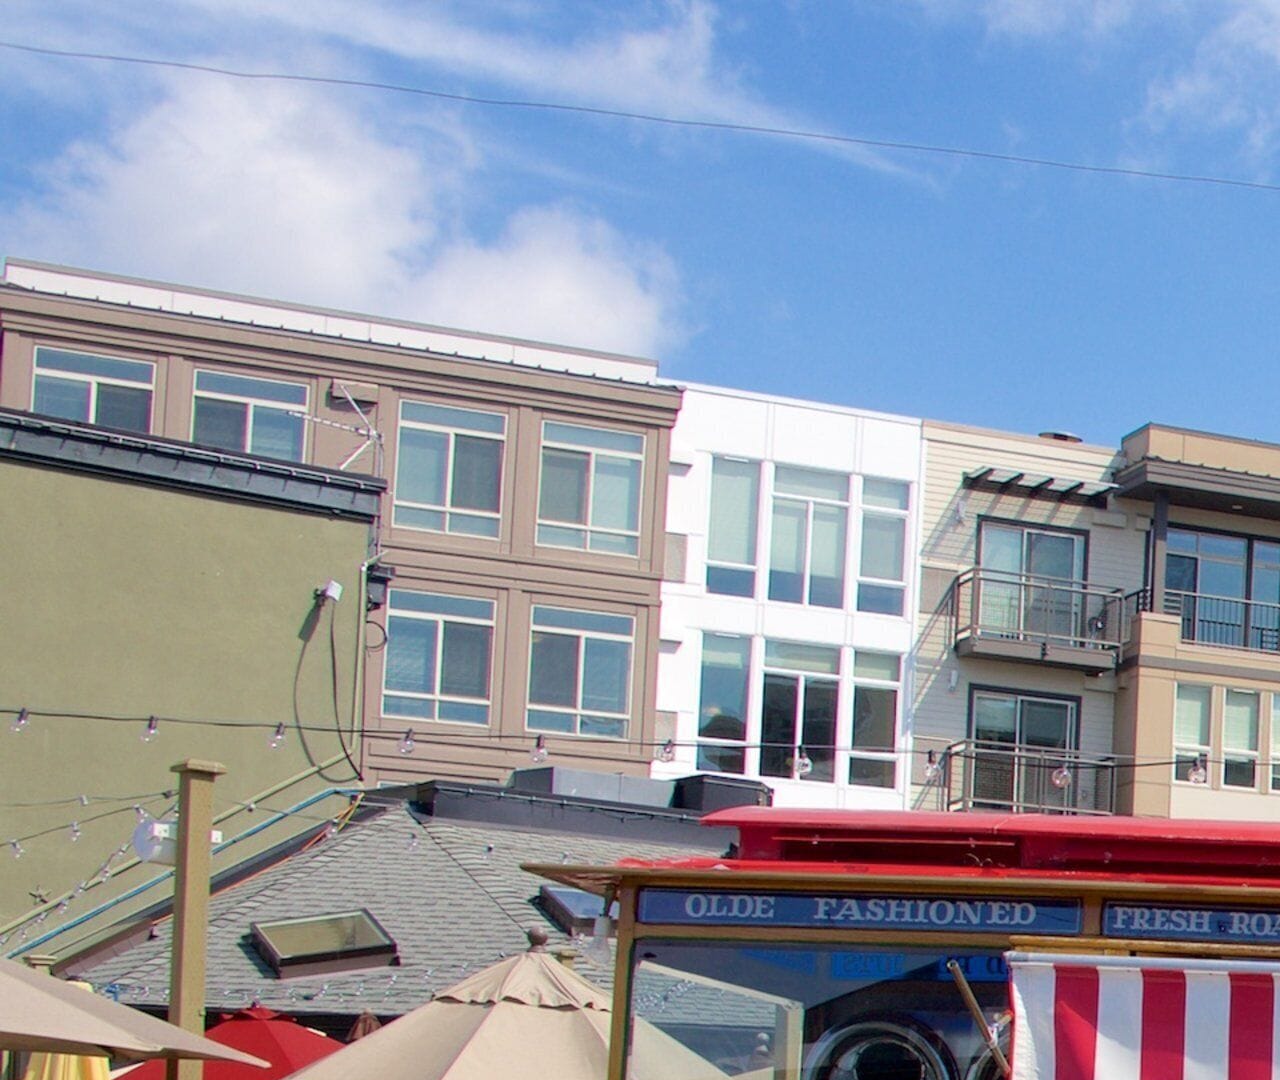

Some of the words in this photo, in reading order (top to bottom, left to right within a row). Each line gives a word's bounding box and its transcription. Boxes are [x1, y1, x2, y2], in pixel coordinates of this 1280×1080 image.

[684, 893, 775, 919] OLDE
[813, 897, 1038, 926] FASHIONED
[1112, 905, 1213, 934] FRESH
